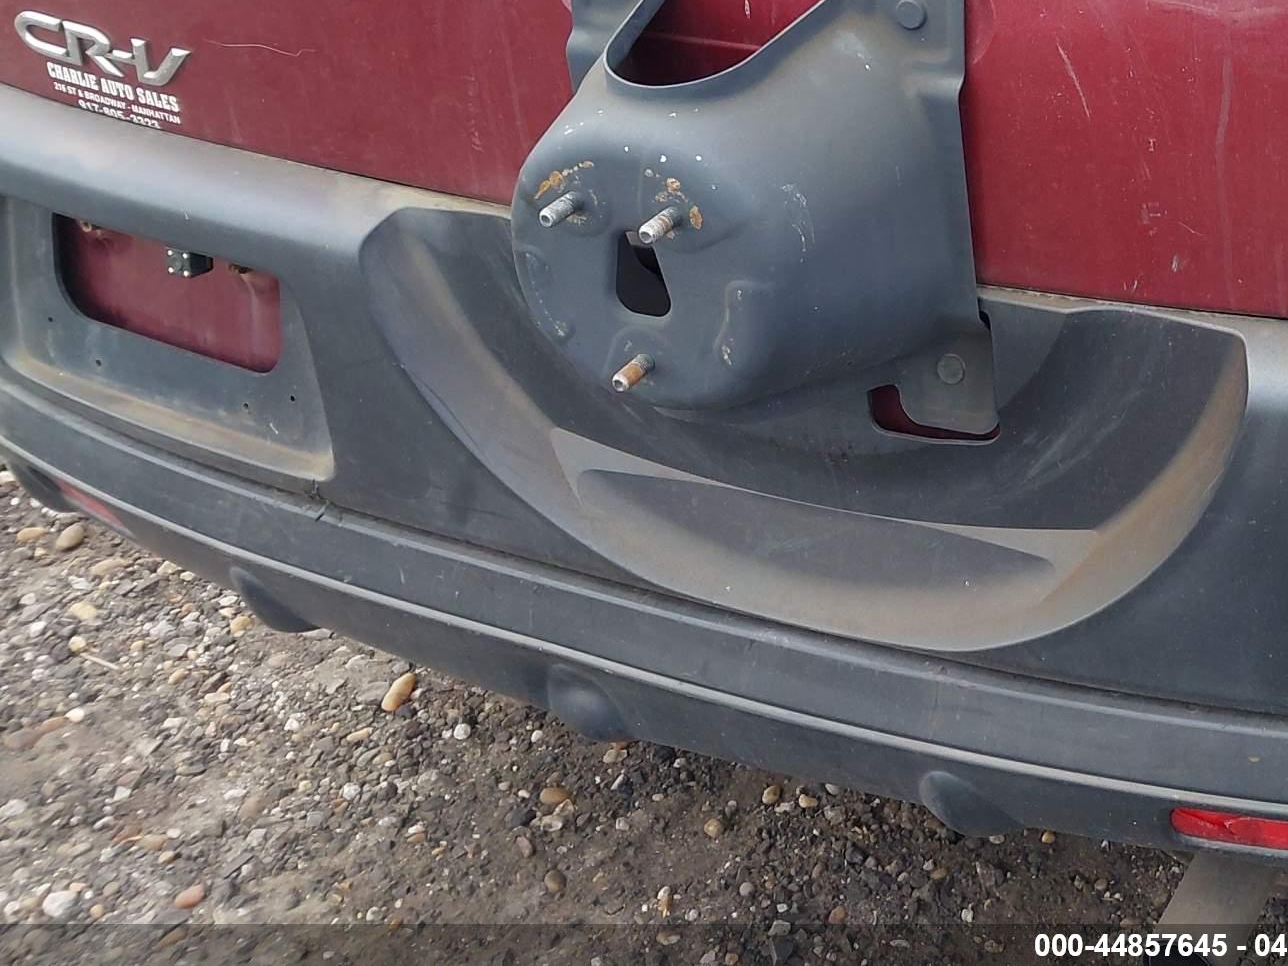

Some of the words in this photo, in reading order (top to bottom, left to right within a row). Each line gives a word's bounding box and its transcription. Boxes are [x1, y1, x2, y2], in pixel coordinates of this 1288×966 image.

[14, 10, 192, 87] CR-V
[46, 61, 99, 91] CHARLIE
[100, 78, 134, 101] AUTO
[136, 87, 181, 113] SALES
[66, 85, 77, 96] ST
[84, 90, 126, 110] BROADWAY
[131, 104, 181, 124] MANHATTAN
